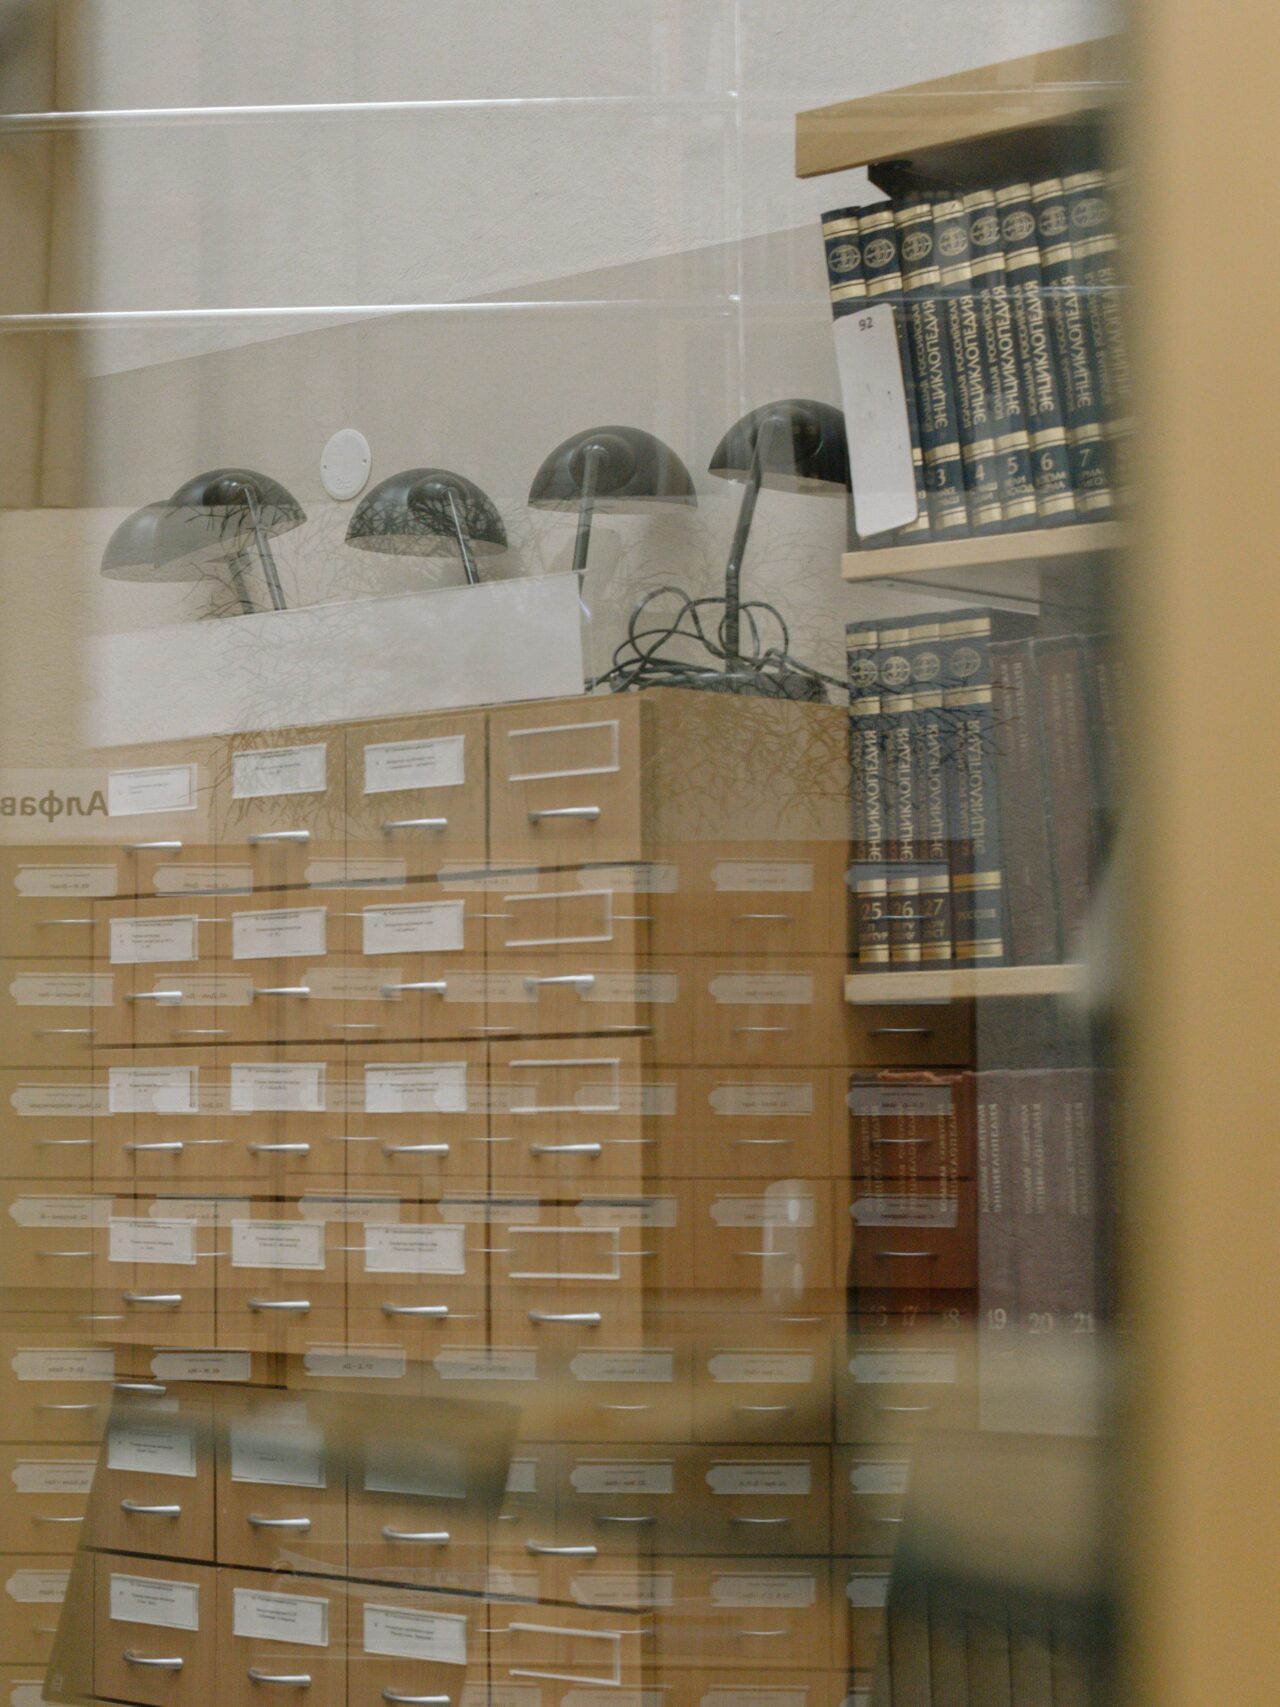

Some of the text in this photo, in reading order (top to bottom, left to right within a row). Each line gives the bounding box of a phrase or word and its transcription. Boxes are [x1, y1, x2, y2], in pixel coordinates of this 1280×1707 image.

[858, 316, 874, 332] 92
[992, 285, 1020, 417] ЭНЦИКЛОПЕДИЯ
[1024, 281, 1054, 412] ЭНЦИКЛОПЕДИЯ
[922, 300, 948, 429] ЭНЦИКЛОПЕДИЯ
[960, 295, 986, 425] ЭНЦИКЛОПЕДИЯ
[1007, 456, 1018, 474] 5
[1041, 452, 1053, 471] 6
[1079, 449, 1090, 467] 7
[936, 468, 946, 486] 3
[975, 464, 985, 480] 4
[864, 730, 882, 862] ЭНЦИКЛОПЕДИЯ
[896, 727, 914, 861] ЭНЦИКЛОПЕДИЯ
[927, 724, 944, 858] ЭНЦИКЛОПЕДИЯ
[967, 720, 986, 854] ЭНЦИКЛОПЕДИЯ
[862, 902, 882, 920] 25
[987, 1308, 1007, 1330] 19
[1029, 1313, 1053, 1334] 20
[1074, 1312, 1094, 1333] 21
